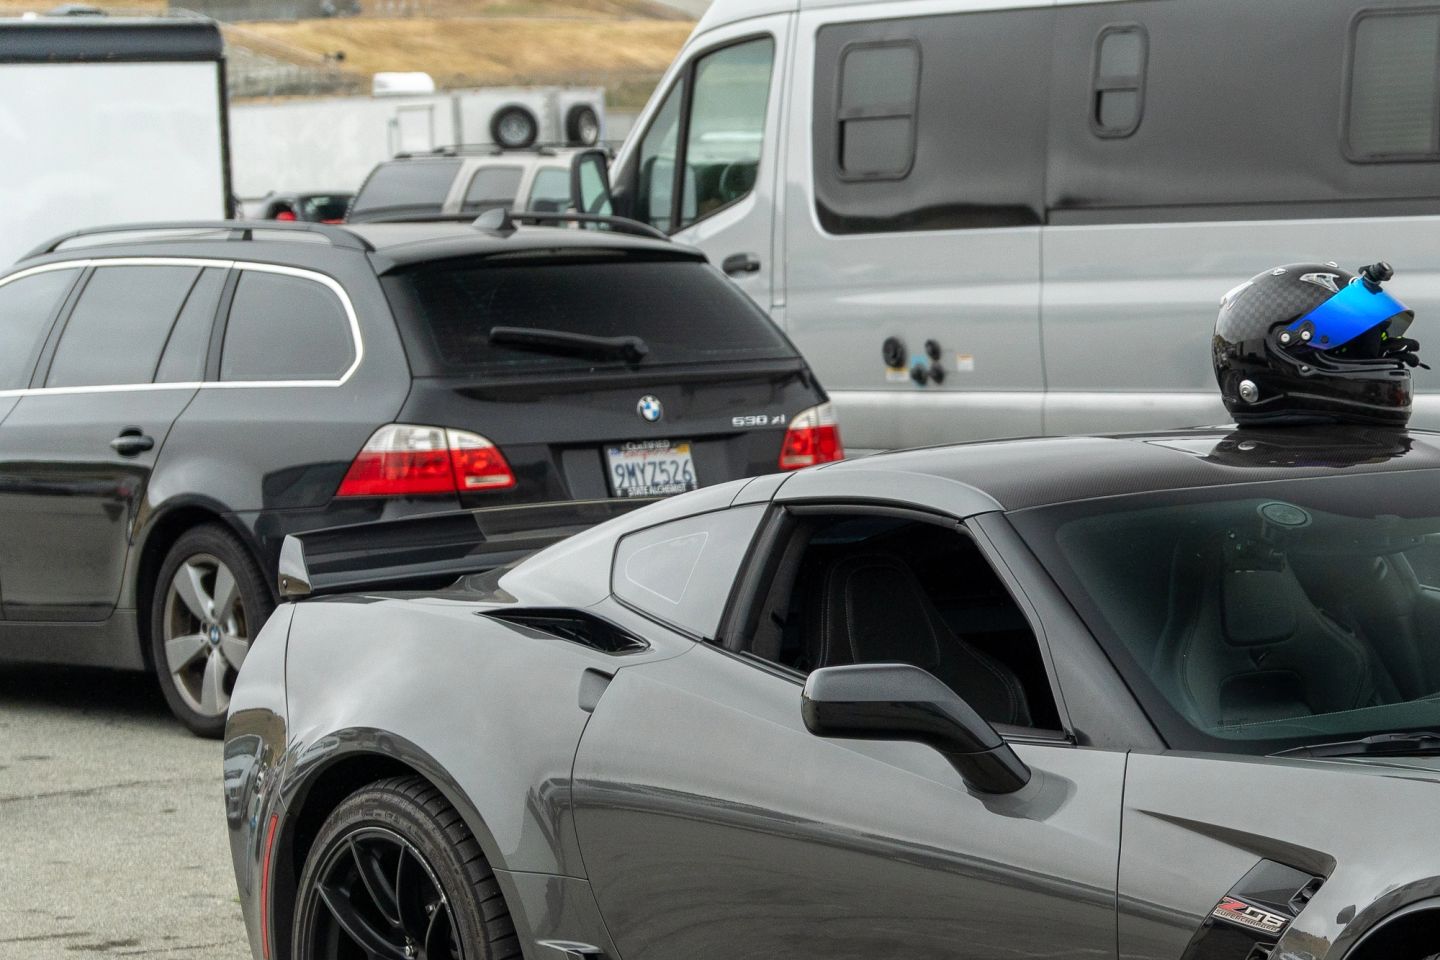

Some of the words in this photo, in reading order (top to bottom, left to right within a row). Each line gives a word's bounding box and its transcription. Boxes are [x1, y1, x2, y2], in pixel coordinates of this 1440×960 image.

[615, 459, 692, 488] 9MYZ526
[1213, 908, 1279, 932] SUPERCHARGED
[1217, 896, 1286, 927] Z06
